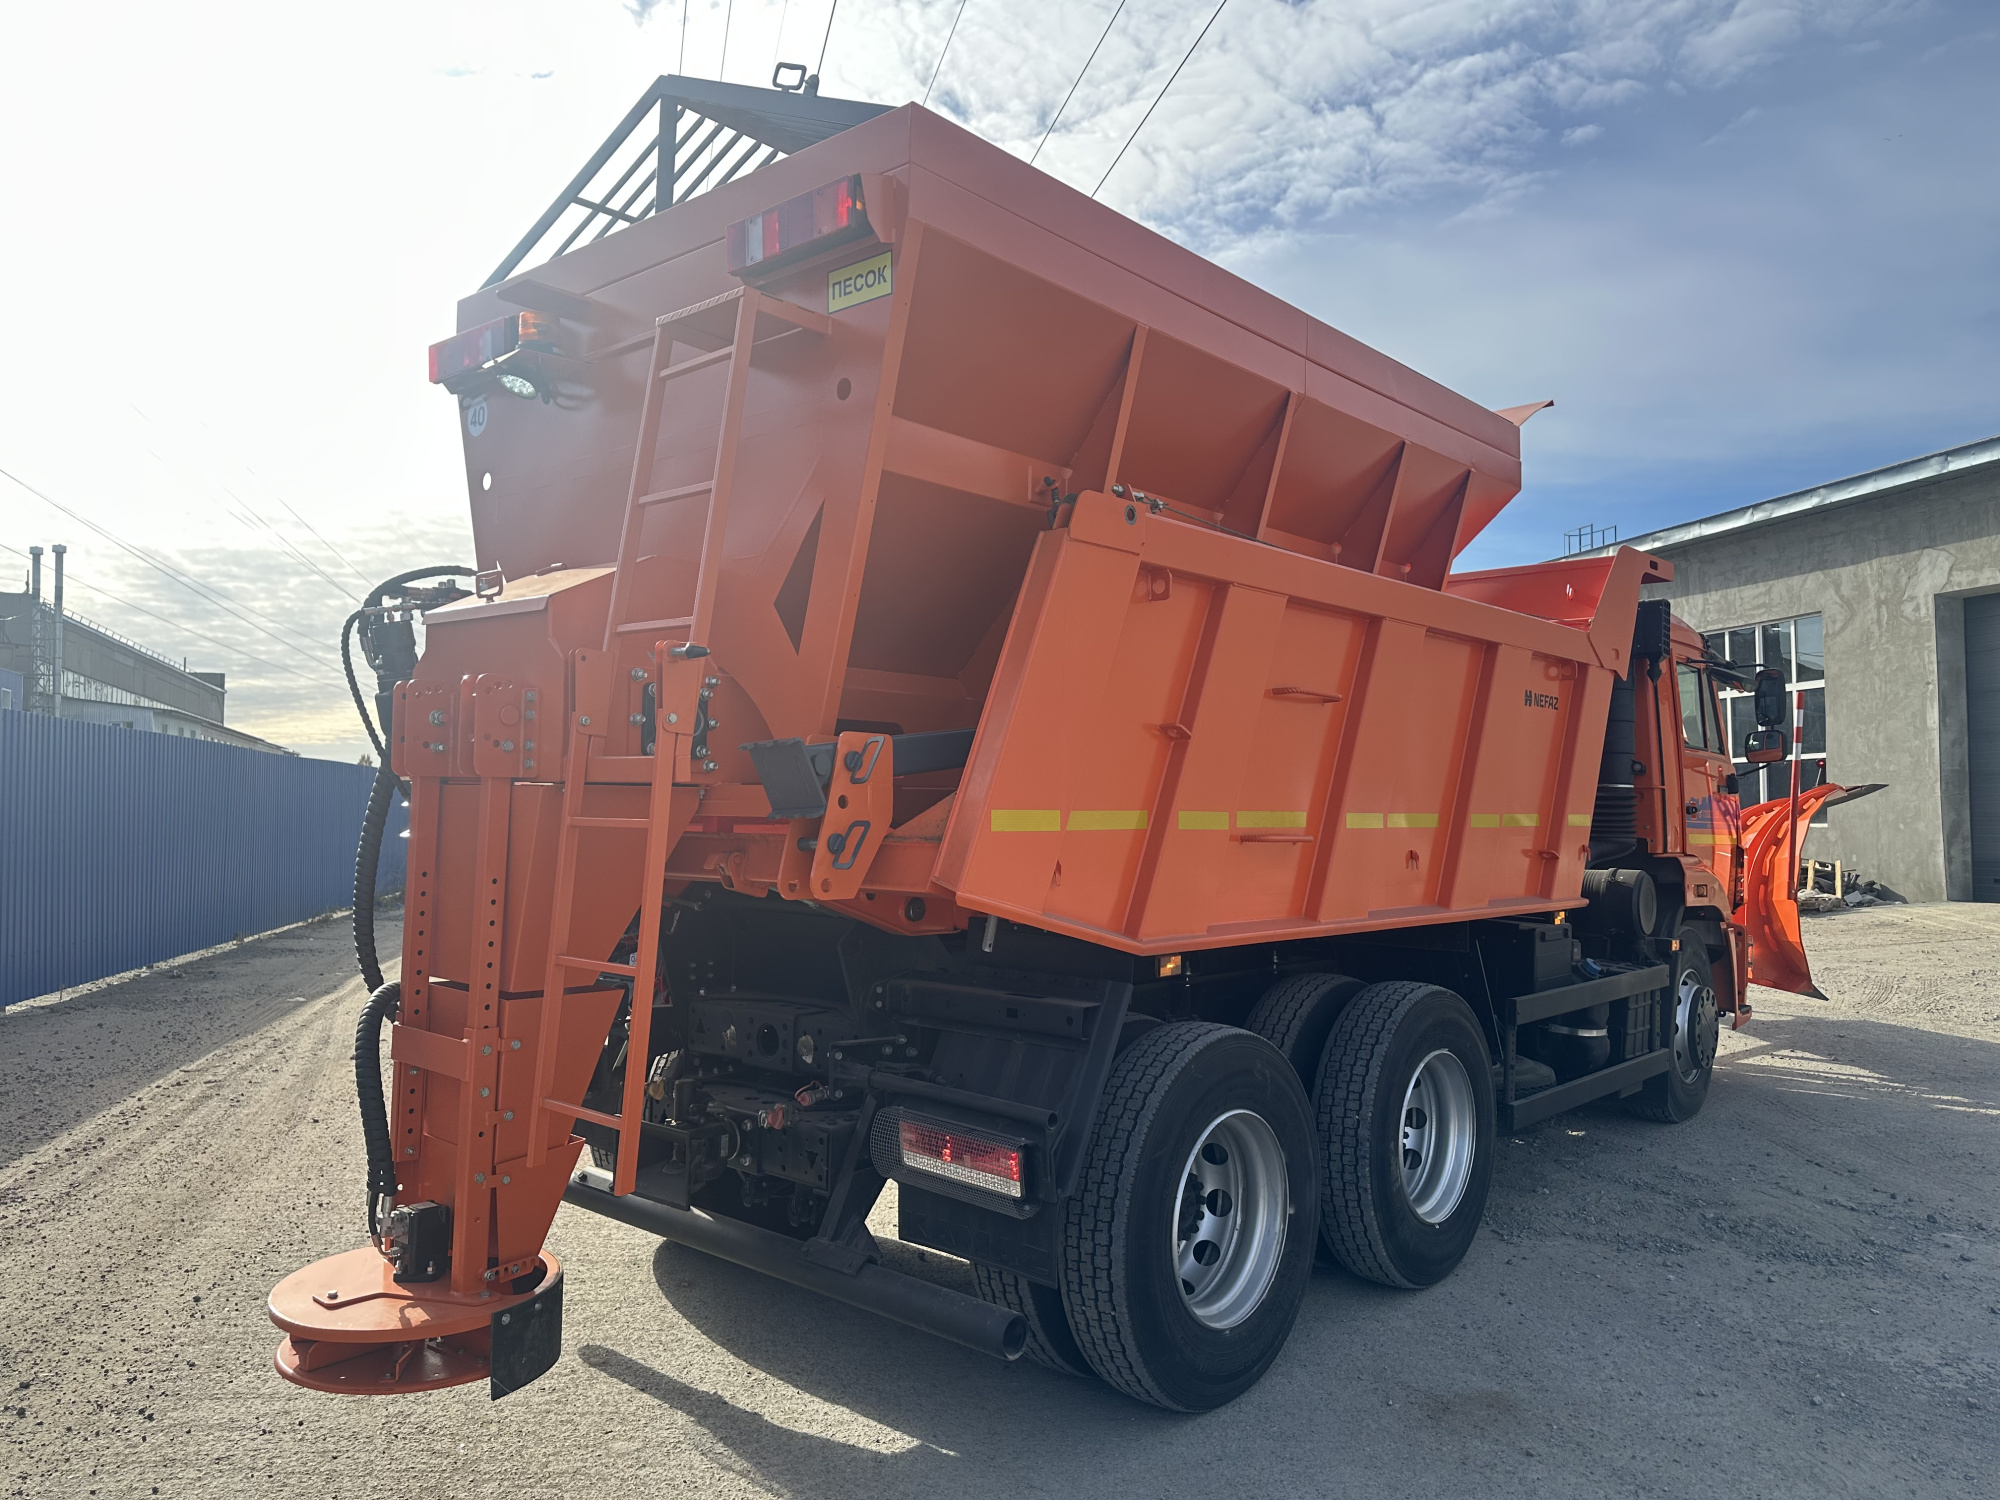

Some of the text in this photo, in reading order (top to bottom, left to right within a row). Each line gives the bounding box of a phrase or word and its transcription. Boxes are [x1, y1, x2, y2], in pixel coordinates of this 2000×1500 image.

[832, 264, 887, 300] ПЕСОК
[470, 406, 485, 427] 40
[1534, 692, 1559, 711] NEFAZ
